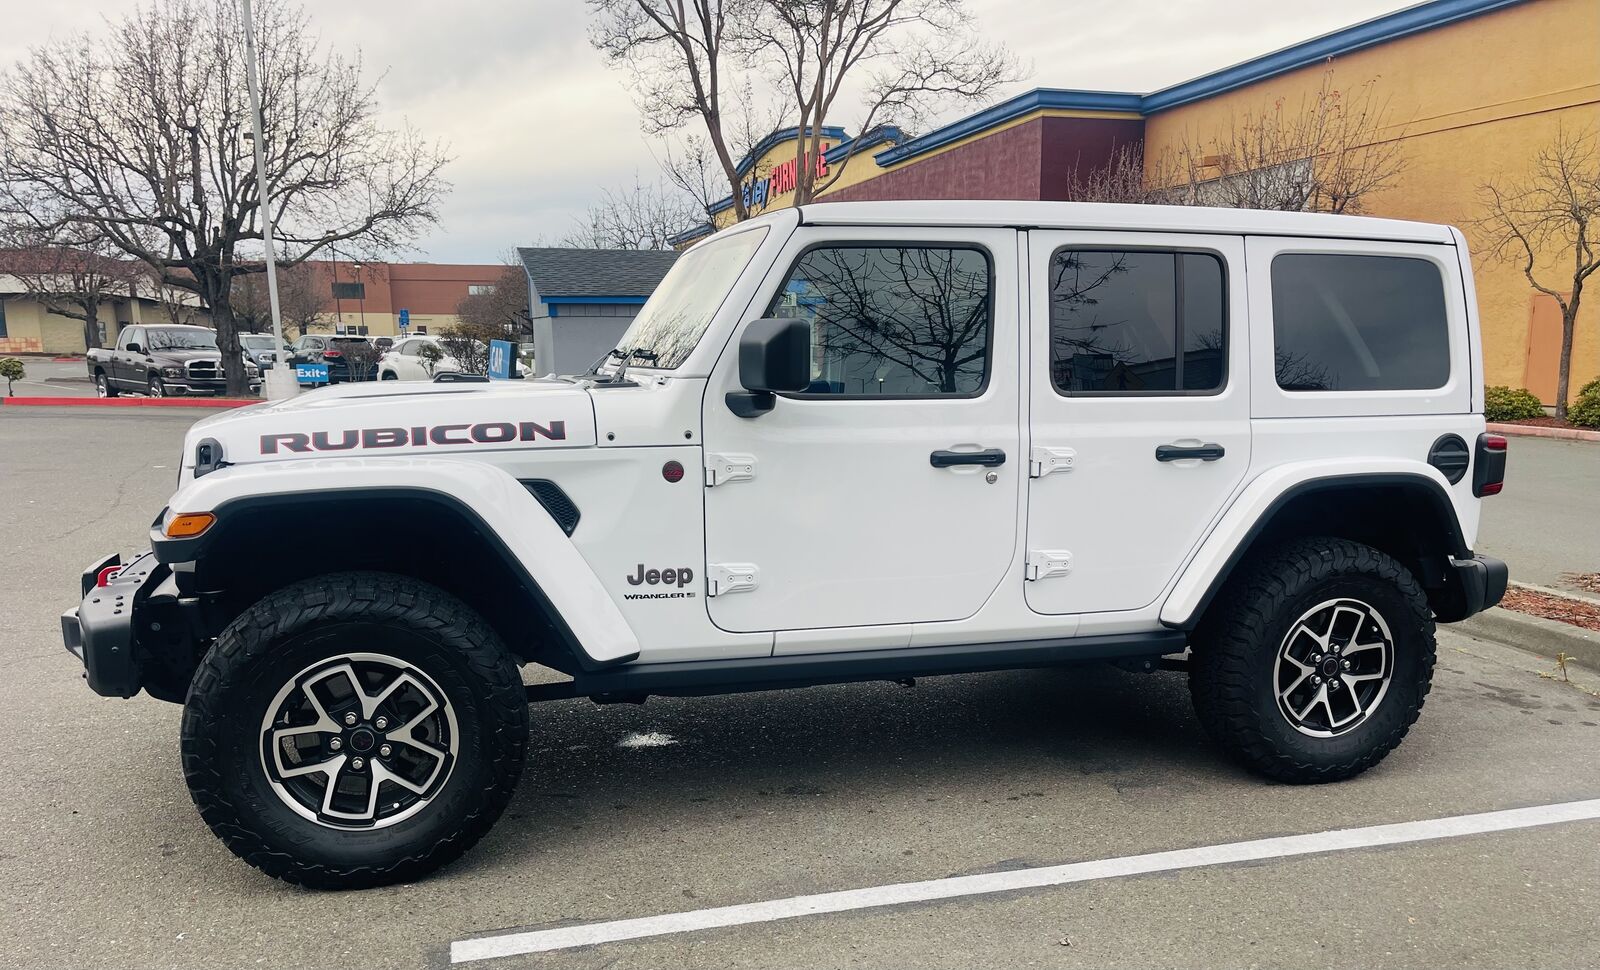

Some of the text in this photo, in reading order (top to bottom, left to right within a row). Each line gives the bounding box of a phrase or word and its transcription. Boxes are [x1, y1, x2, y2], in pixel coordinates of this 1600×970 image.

[491, 346, 503, 374] CAR
[297, 368, 321, 378] Exit
[260, 420, 566, 455] RUBICON
[626, 563, 694, 588] Jeep
[624, 592, 685, 600] WRANGLER
